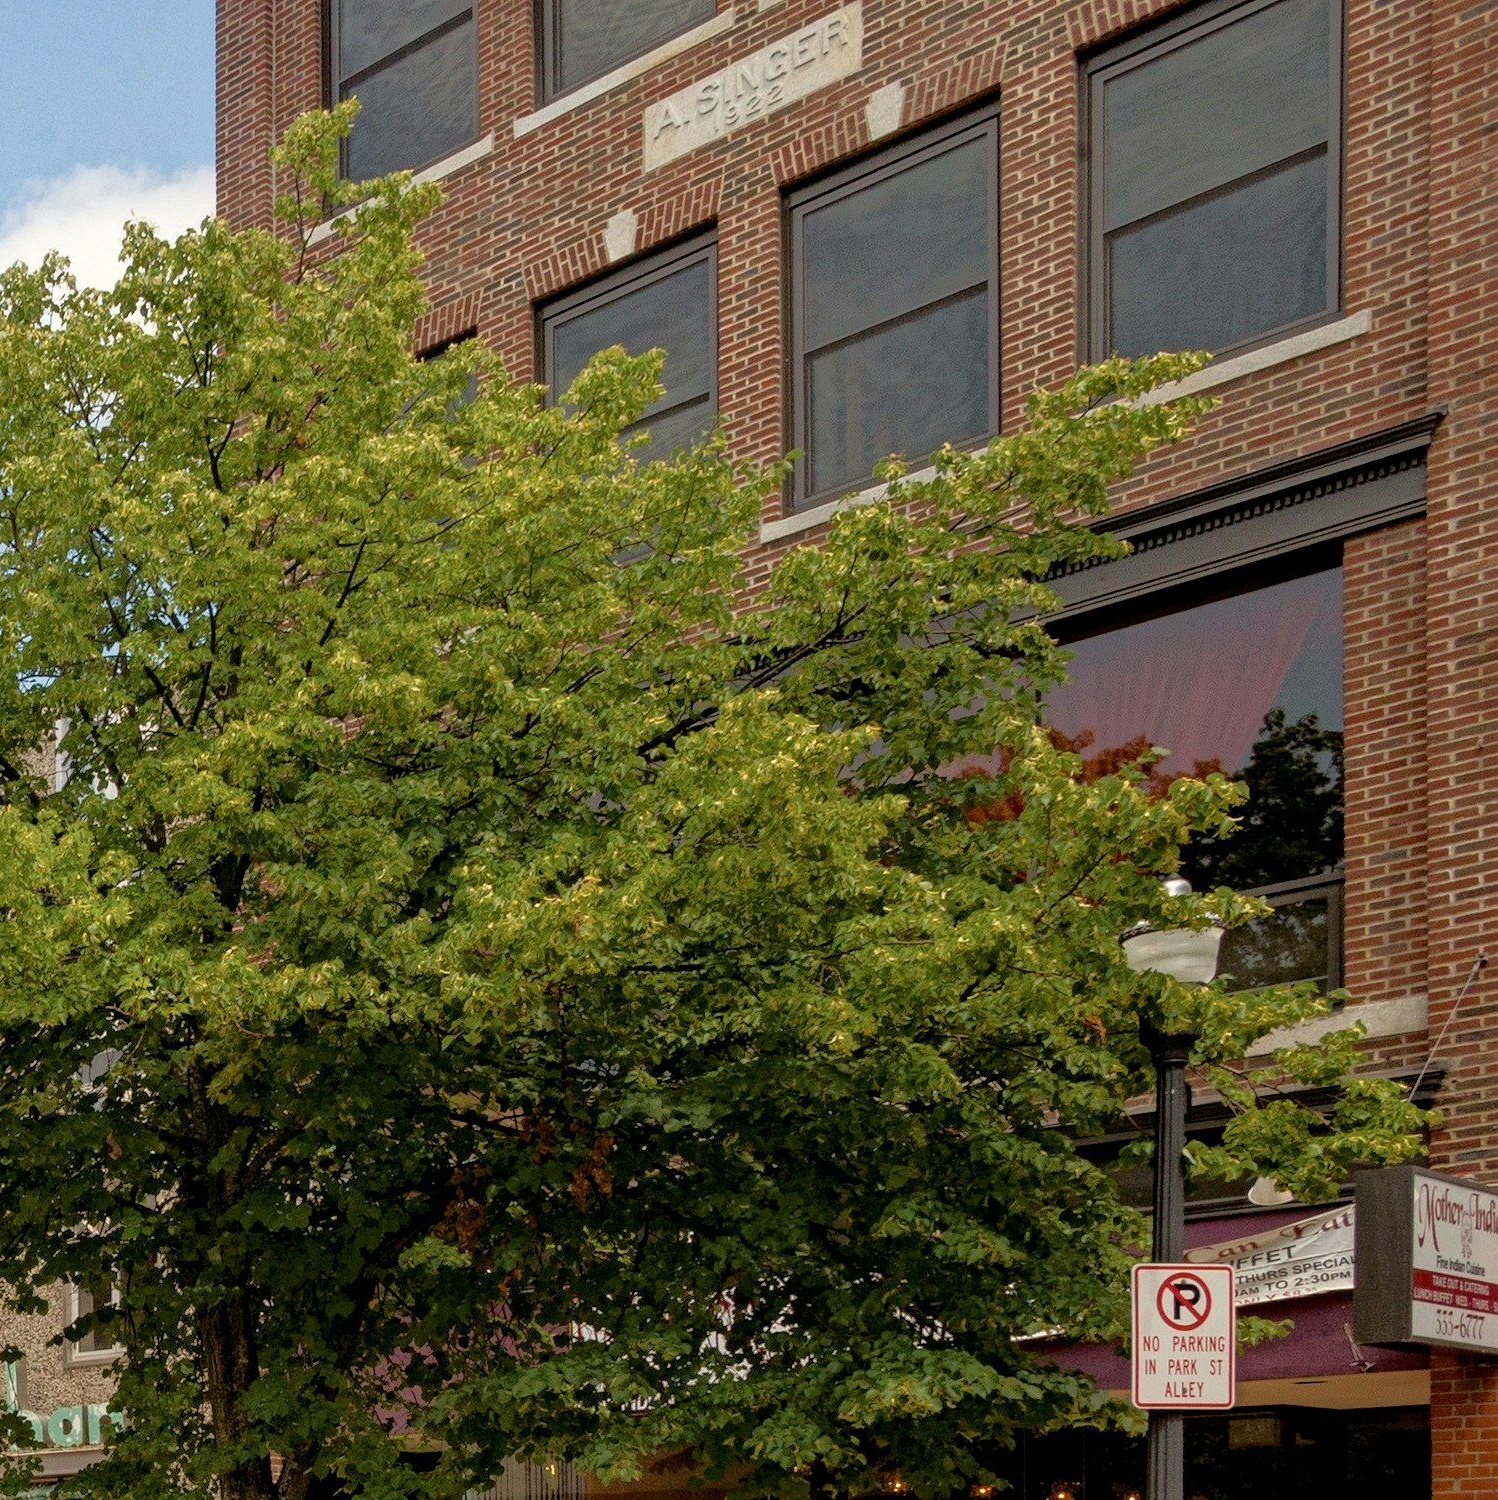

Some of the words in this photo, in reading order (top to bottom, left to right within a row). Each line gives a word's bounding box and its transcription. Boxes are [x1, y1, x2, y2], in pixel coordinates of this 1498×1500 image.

[696, 14, 850, 116] SINGER
[713, 83, 785, 133] 1922
[1417, 1183, 1464, 1252] Mother
[1236, 1268, 1289, 1285] THURS
[1264, 1280, 1288, 1292] TO
[1294, 1270, 1351, 1287] 2:30PM
[1435, 1308, 1485, 1339] 333-6777
[1143, 1336, 1160, 1352] NO
[1172, 1336, 1225, 1353] PARKING
[1145, 1359, 1157, 1375] IN
[1168, 1359, 1197, 1376] PARK
[1209, 1360, 1223, 1376] ST
[1164, 1382, 1204, 1398] ALLEY
